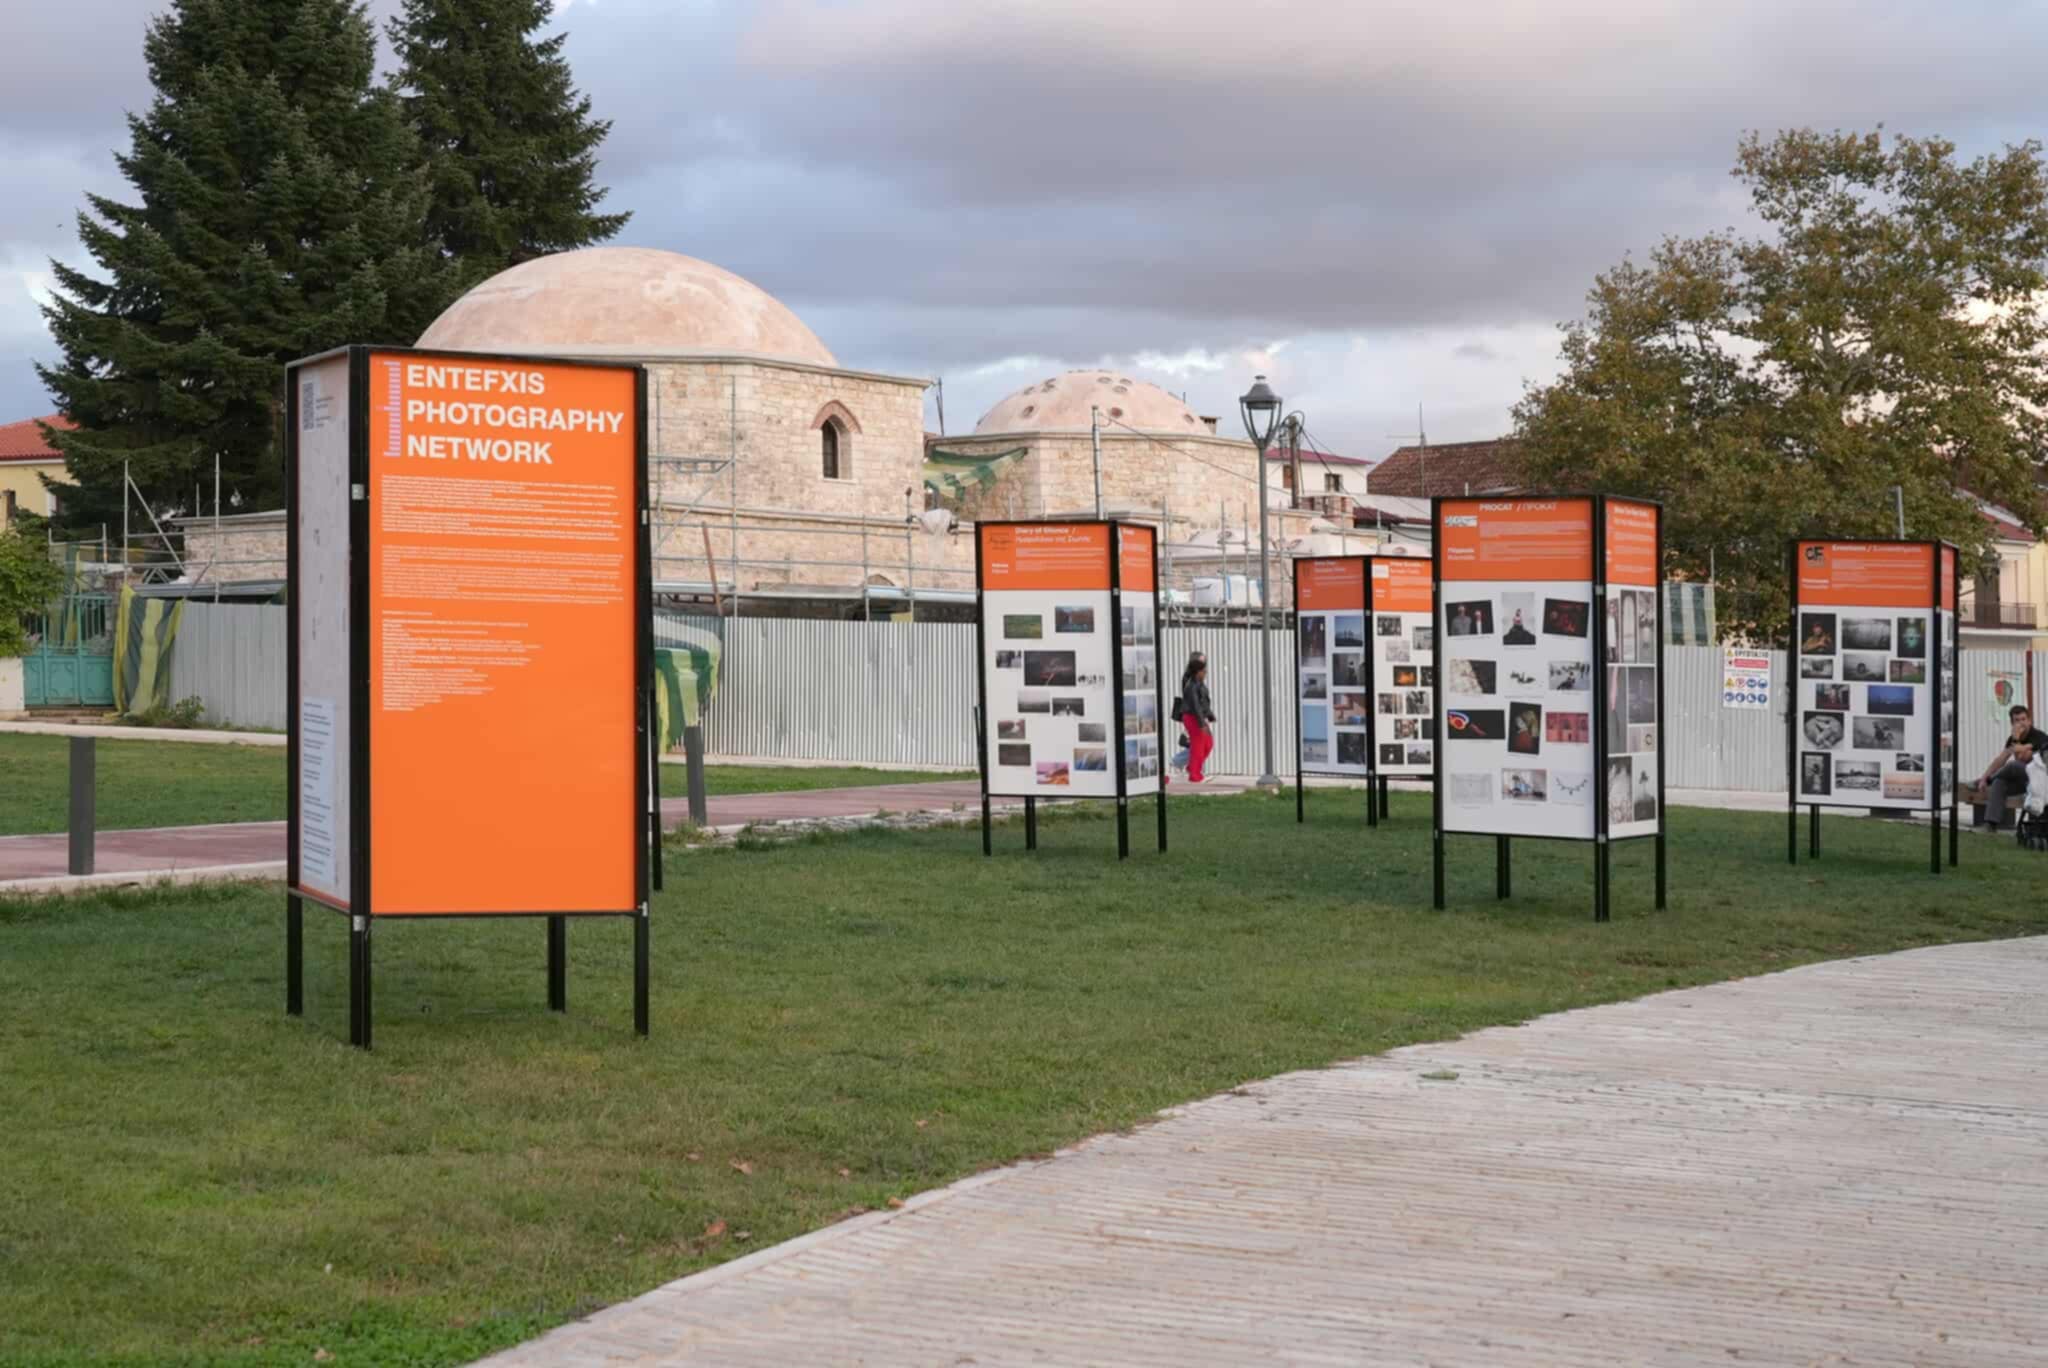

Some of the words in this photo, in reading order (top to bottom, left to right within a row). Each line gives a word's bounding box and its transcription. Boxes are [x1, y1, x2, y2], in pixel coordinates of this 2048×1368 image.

[407, 365, 544, 394] ENTEFXIS
[407, 400, 624, 433] PHOTOGRAPHY
[407, 434, 552, 464] NETWORK
